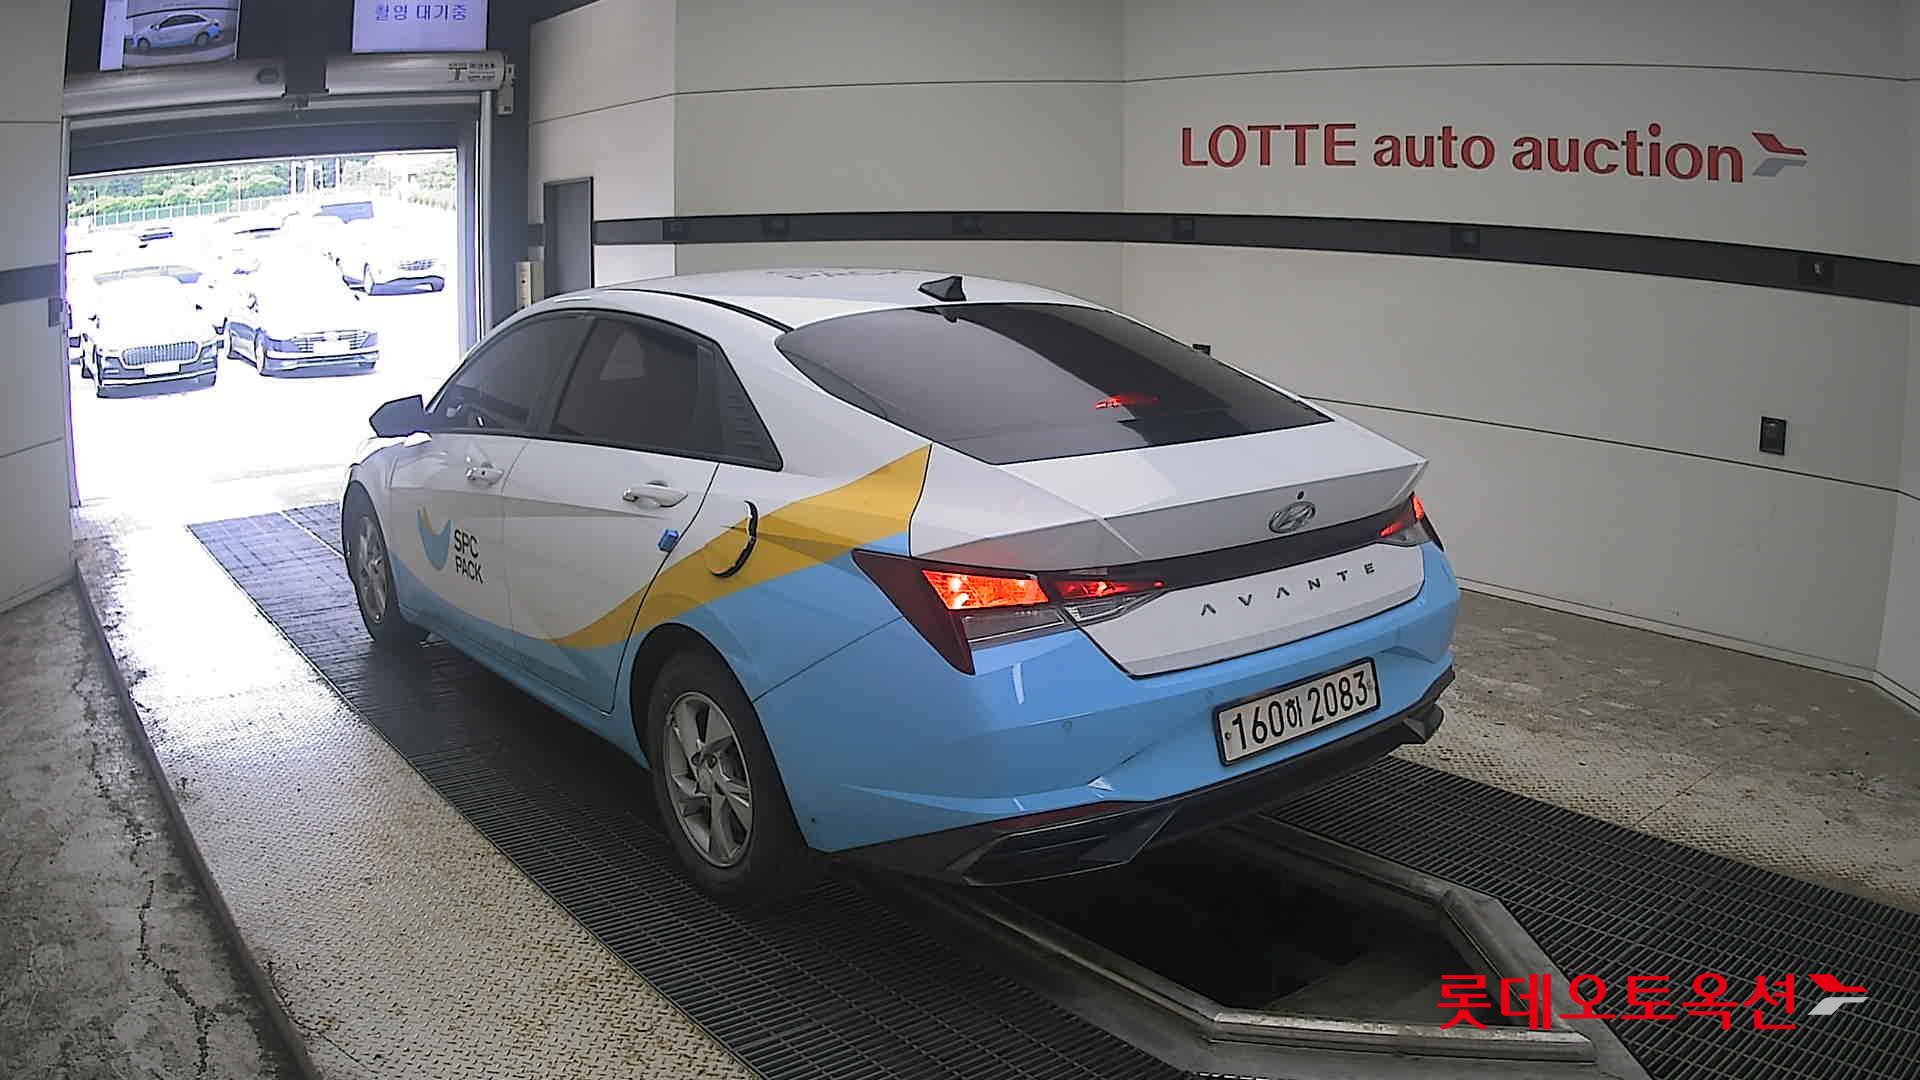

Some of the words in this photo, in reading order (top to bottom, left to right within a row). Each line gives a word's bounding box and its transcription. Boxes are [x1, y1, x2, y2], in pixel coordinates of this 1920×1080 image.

[416, 3, 467, 21] 대기중
[1181, 123, 1356, 168] LOTTE
[1373, 126, 1496, 170] auto
[1511, 123, 1744, 183] auction
[454, 528, 479, 558] SPC
[455, 555, 484, 585] PACK
[1201, 561, 1375, 616] AVANTE
[1231, 695, 1304, 750] 160하
[1307, 670, 1368, 725] 2083
